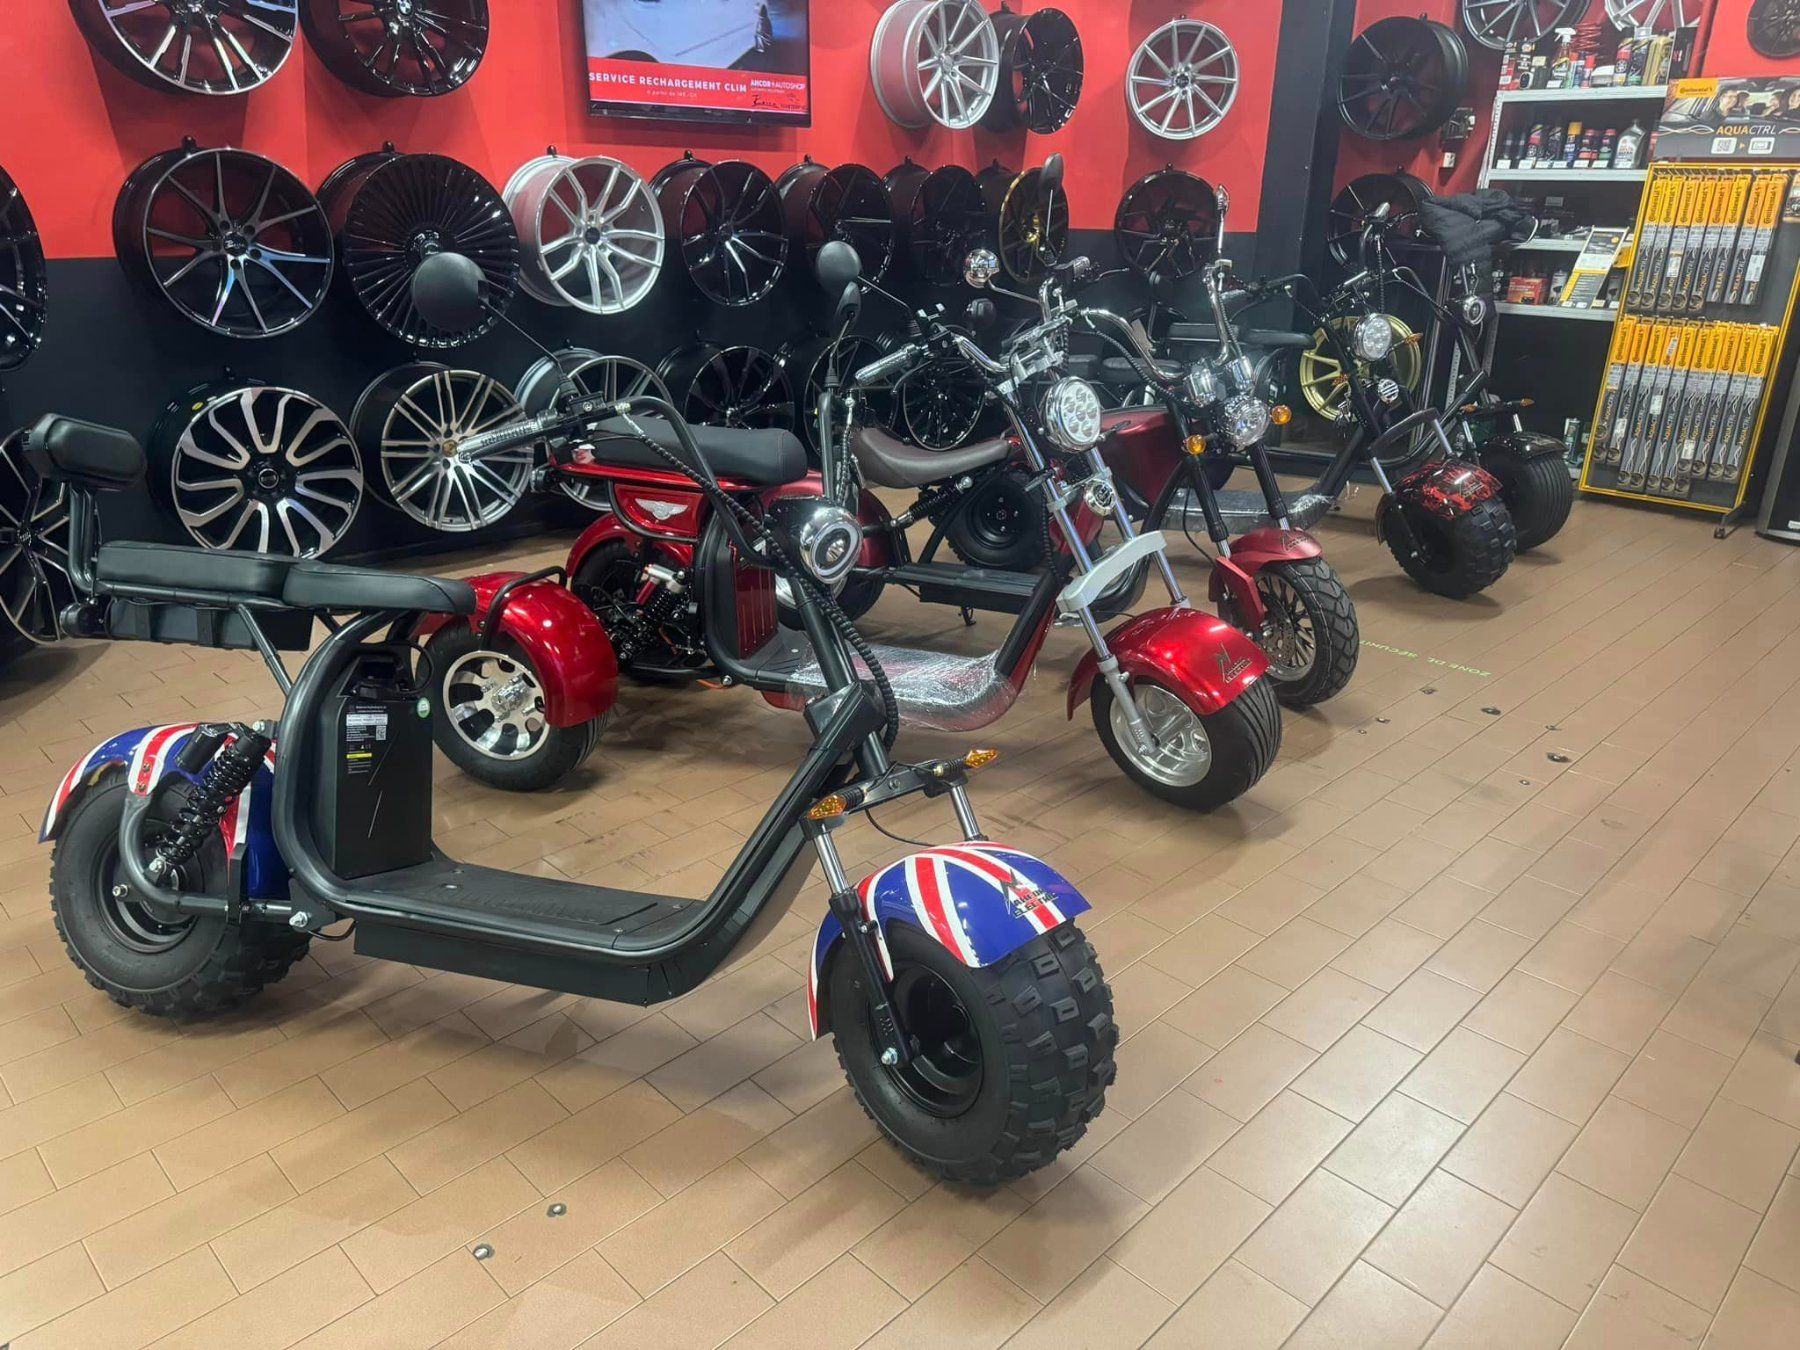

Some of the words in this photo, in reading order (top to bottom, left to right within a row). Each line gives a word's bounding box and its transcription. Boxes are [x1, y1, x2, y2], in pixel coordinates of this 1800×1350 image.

[589, 72, 635, 84] SERVICE
[639, 76, 721, 90] RECHARGEMENT
[724, 83, 747, 92] CLIM
[1716, 125, 1777, 135] AQUACTRL
[1448, 664, 1492, 677] ZONE
